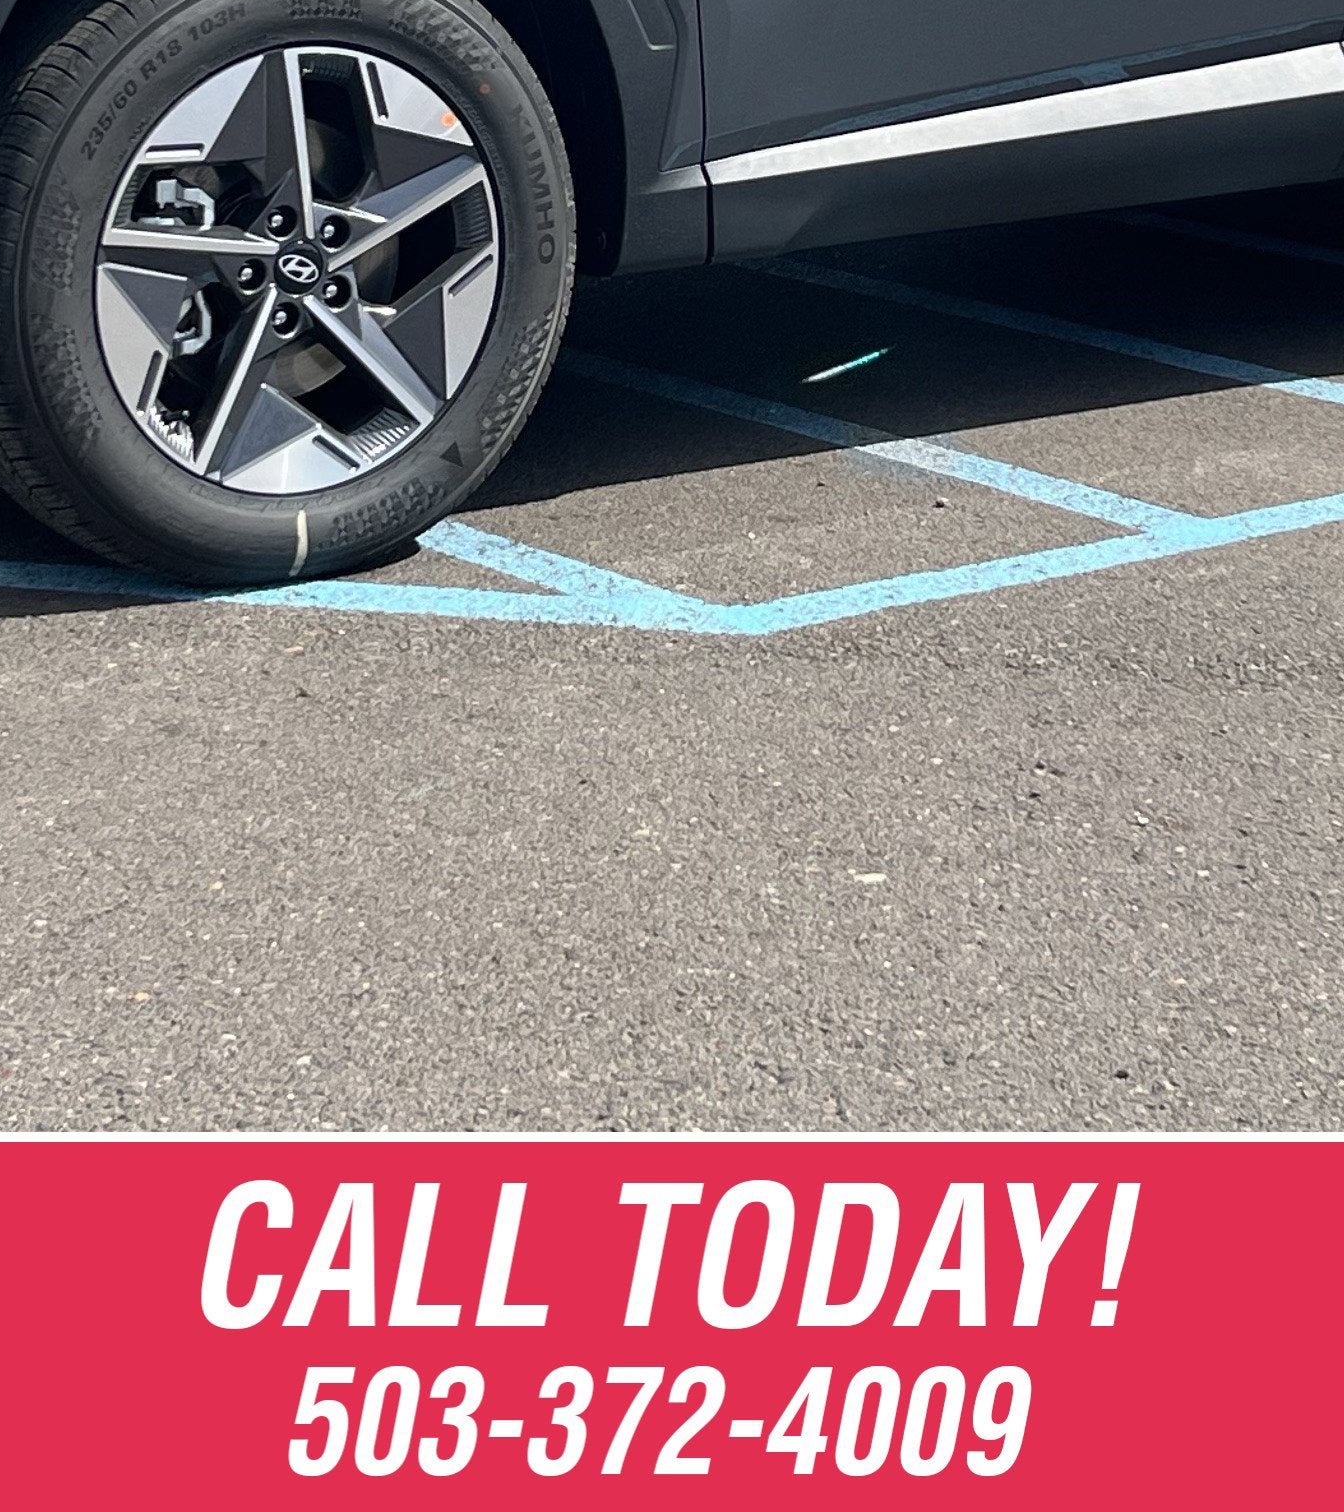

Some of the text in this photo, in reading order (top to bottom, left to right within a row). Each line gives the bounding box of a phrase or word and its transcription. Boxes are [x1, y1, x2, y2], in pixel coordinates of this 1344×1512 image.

[80, 79, 138, 161] 235/60
[187, 2, 246, 41] 103H
[511, 102, 556, 265] KUMHO
